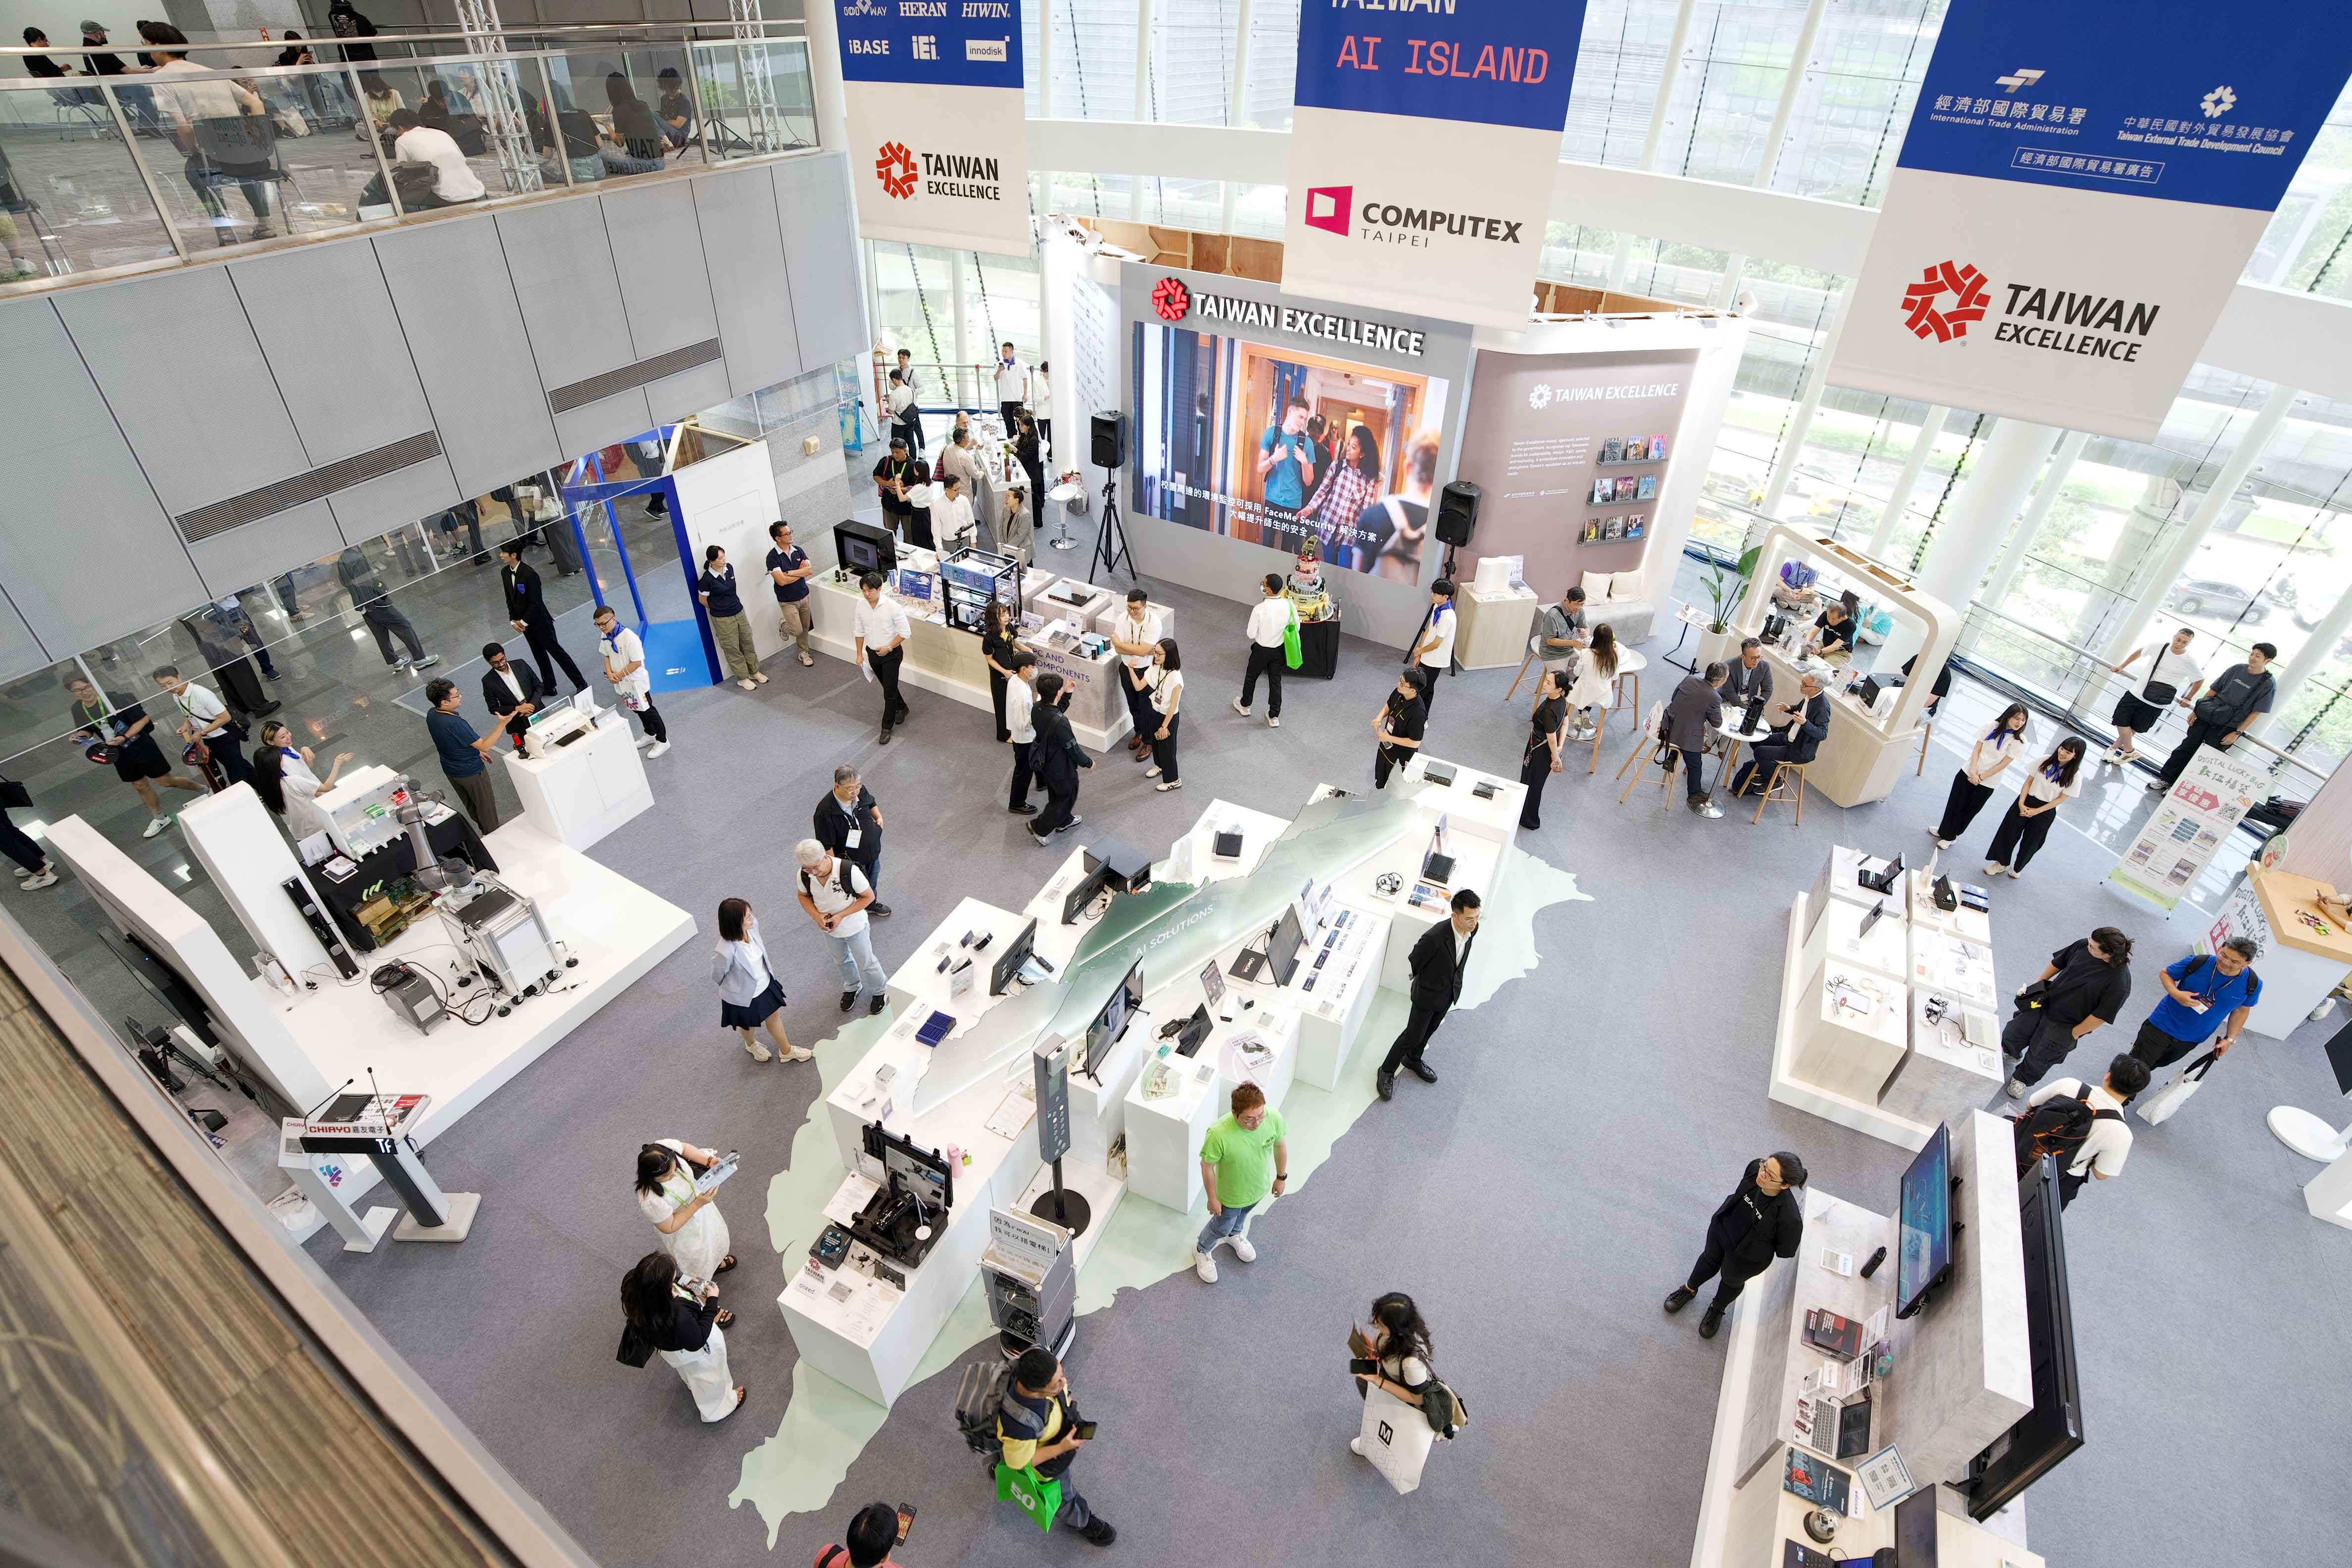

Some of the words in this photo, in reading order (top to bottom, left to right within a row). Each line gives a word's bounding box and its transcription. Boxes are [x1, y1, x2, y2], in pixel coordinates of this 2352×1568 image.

[898, 1, 947, 17] HERAN
[961, 2, 1009, 18] HIWIN
[848, 39, 890, 55] iBASE
[969, 46, 1003, 56] innodisk
[1337, 35, 1381, 70] AI
[1404, 40, 1548, 84] ISLAND
[1934, 94, 2087, 125] 經濟部國際貿易署
[1930, 113, 1985, 126] International
[1988, 119, 2011, 129] Trade
[2014, 122, 2079, 136] Administration
[2123, 116, 2295, 143] 中華民國對外貿易發展協會
[2116, 130, 2144, 143] Taiwan
[2144, 133, 2177, 145] External
[2178, 138, 2199, 148] Trade
[2200, 139, 2252, 153] Development
[2252, 143, 2285, 155] Council
[922, 153, 999, 182] TAIWAN
[2019, 152, 2154, 178] 經濟部國際貿易署廣告
[927, 181, 1000, 201] EXCELLENCE
[1362, 203, 1523, 244] COMPUTEX
[1361, 228, 1429, 248] TAIPEI
[2004, 283, 2160, 337] TAIWAN
[1193, 293, 1278, 329] TAIWAN
[1282, 306, 1424, 357] EXCELLENCE
[1995, 322, 2142, 363] EXCELLENCE
[1555, 387, 1604, 402] TAIWAN
[1606, 383, 1679, 400] EXCELLENCE
[1161, 480, 1262, 513] 校園周邊的環境監控可採用
[1265, 507, 1297, 523] FaceMe
[1299, 515, 1336, 534] Security
[1229, 509, 1308, 537] 大幅提升師生的安全
[1036, 659, 1090, 683] OMPONENTS
[1045, 653, 1064, 664] AND
[2198, 755, 2225, 768] DIGITAL
[2228, 763, 2250, 780] LUCKY
[2250, 776, 2265, 789] BAG
[1135, 944, 1146, 959] AI
[1150, 904, 1213, 949] SOLUTIONS
[805, 1266, 824, 1280] TAIWAN
